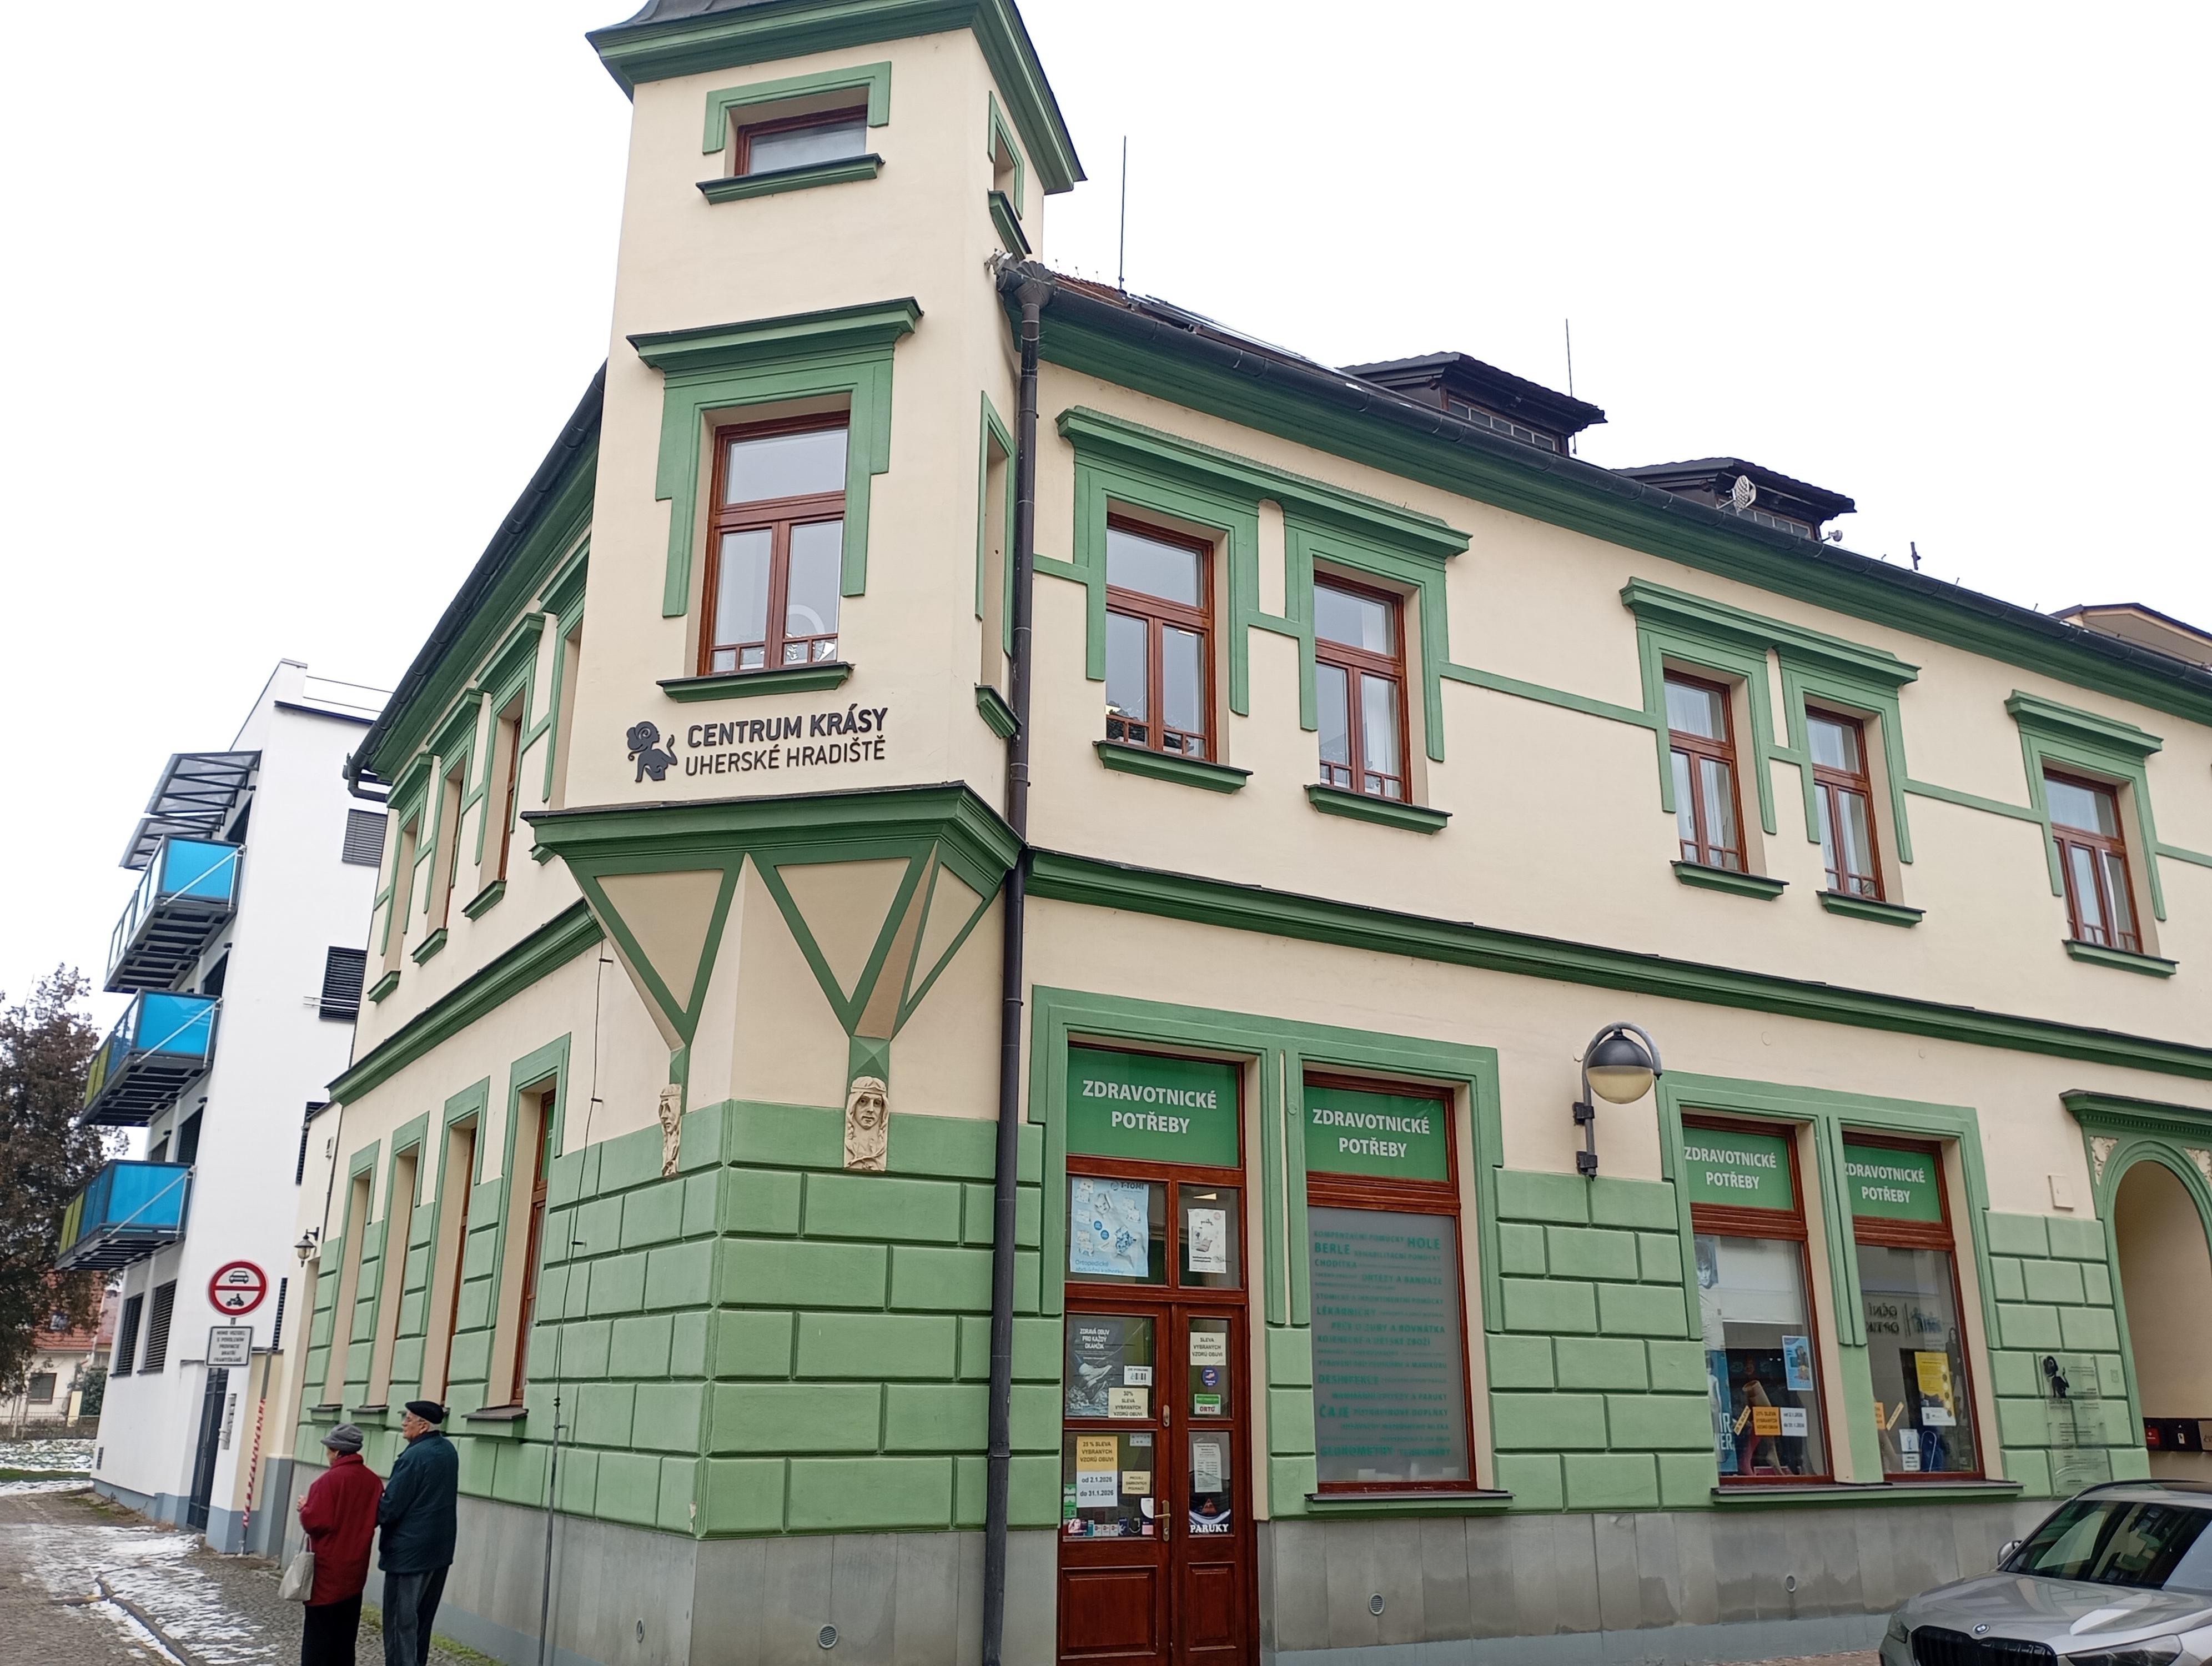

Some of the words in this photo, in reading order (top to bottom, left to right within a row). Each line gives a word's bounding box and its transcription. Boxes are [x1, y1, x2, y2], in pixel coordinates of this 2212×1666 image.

[688, 716, 802, 747] CENTRUM
[810, 703, 888, 737] KRÁSY
[686, 744, 780, 776] UHERSKÉ
[787, 735, 886, 767] HRADIŠTĚ
[1083, 1080, 1217, 1109] ZDRAVOTNICKÉ
[1112, 1111, 1190, 1133] POTŘEBY
[1313, 1108, 1430, 1135] ZDRAVOTNICKÉ
[1339, 1137, 1407, 1158] POTŘEBY
[1684, 1146, 1777, 1168] ZDRAVOTNICKÉ
[1706, 1171, 1759, 1190] POTŘEBY
[1861, 1186, 1911, 1203] POTŘEBY
[1315, 1242, 1350, 1254] BERLE
[1407, 1237, 1440, 1250] HOLE
[1320, 1404, 1349, 1417] ČAJE
[1190, 1524, 1229, 1533] PARUKY
